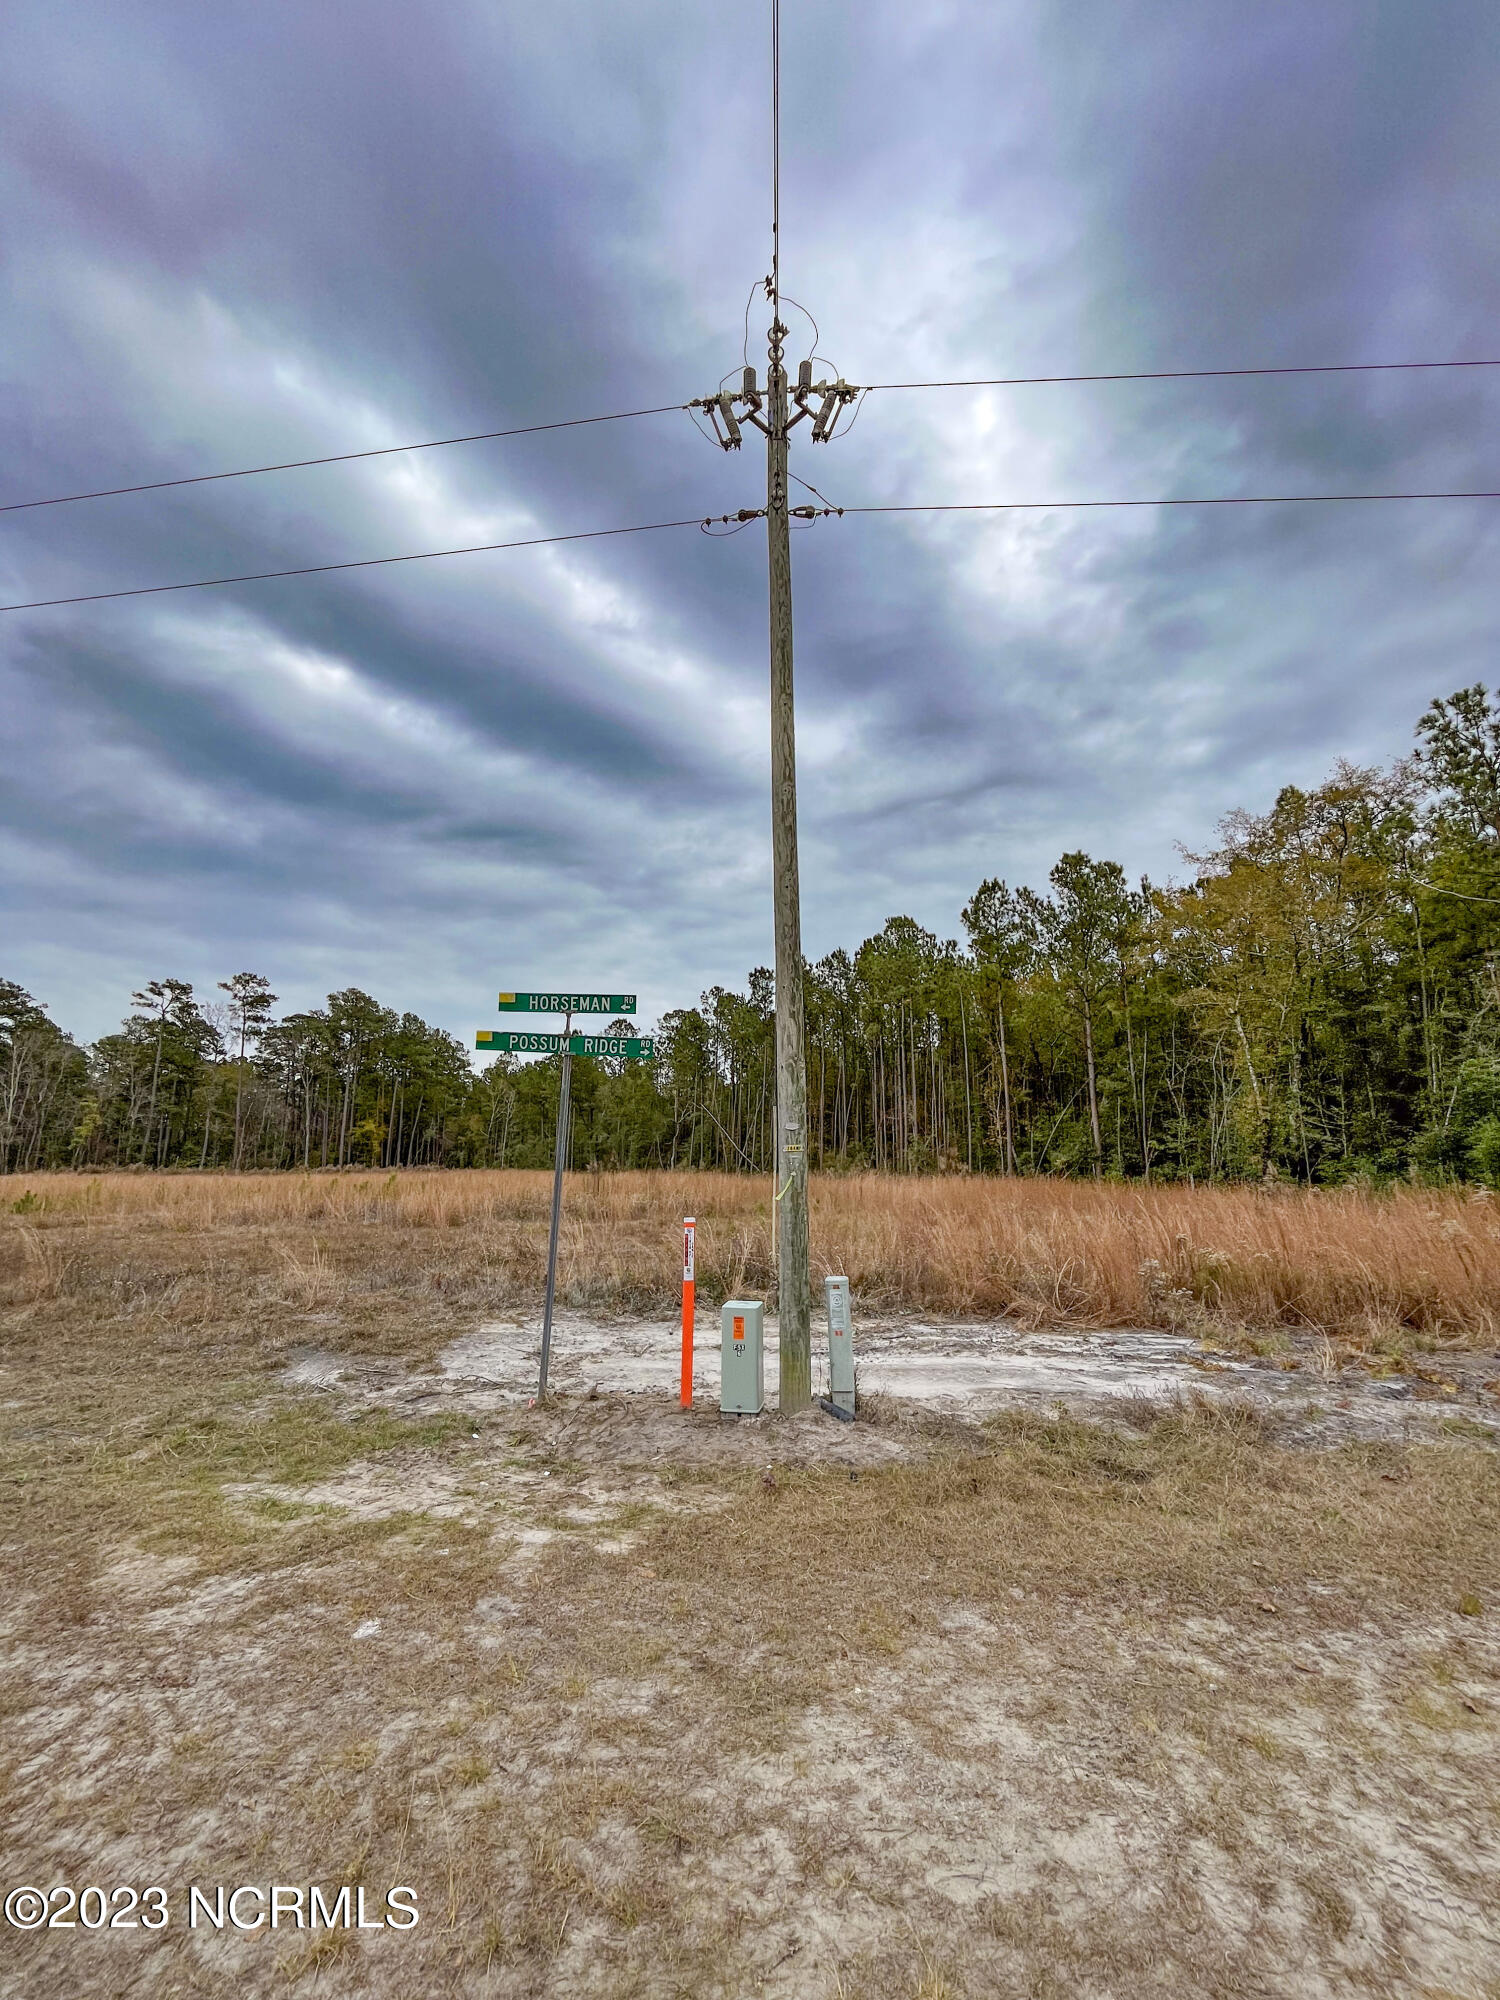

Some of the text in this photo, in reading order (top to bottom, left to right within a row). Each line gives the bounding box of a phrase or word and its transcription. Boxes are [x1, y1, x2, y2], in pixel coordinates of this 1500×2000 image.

[529, 995, 634, 1011] HORSEMAN RD
[509, 1035, 651, 1054] POSSUM RIDGE RD
